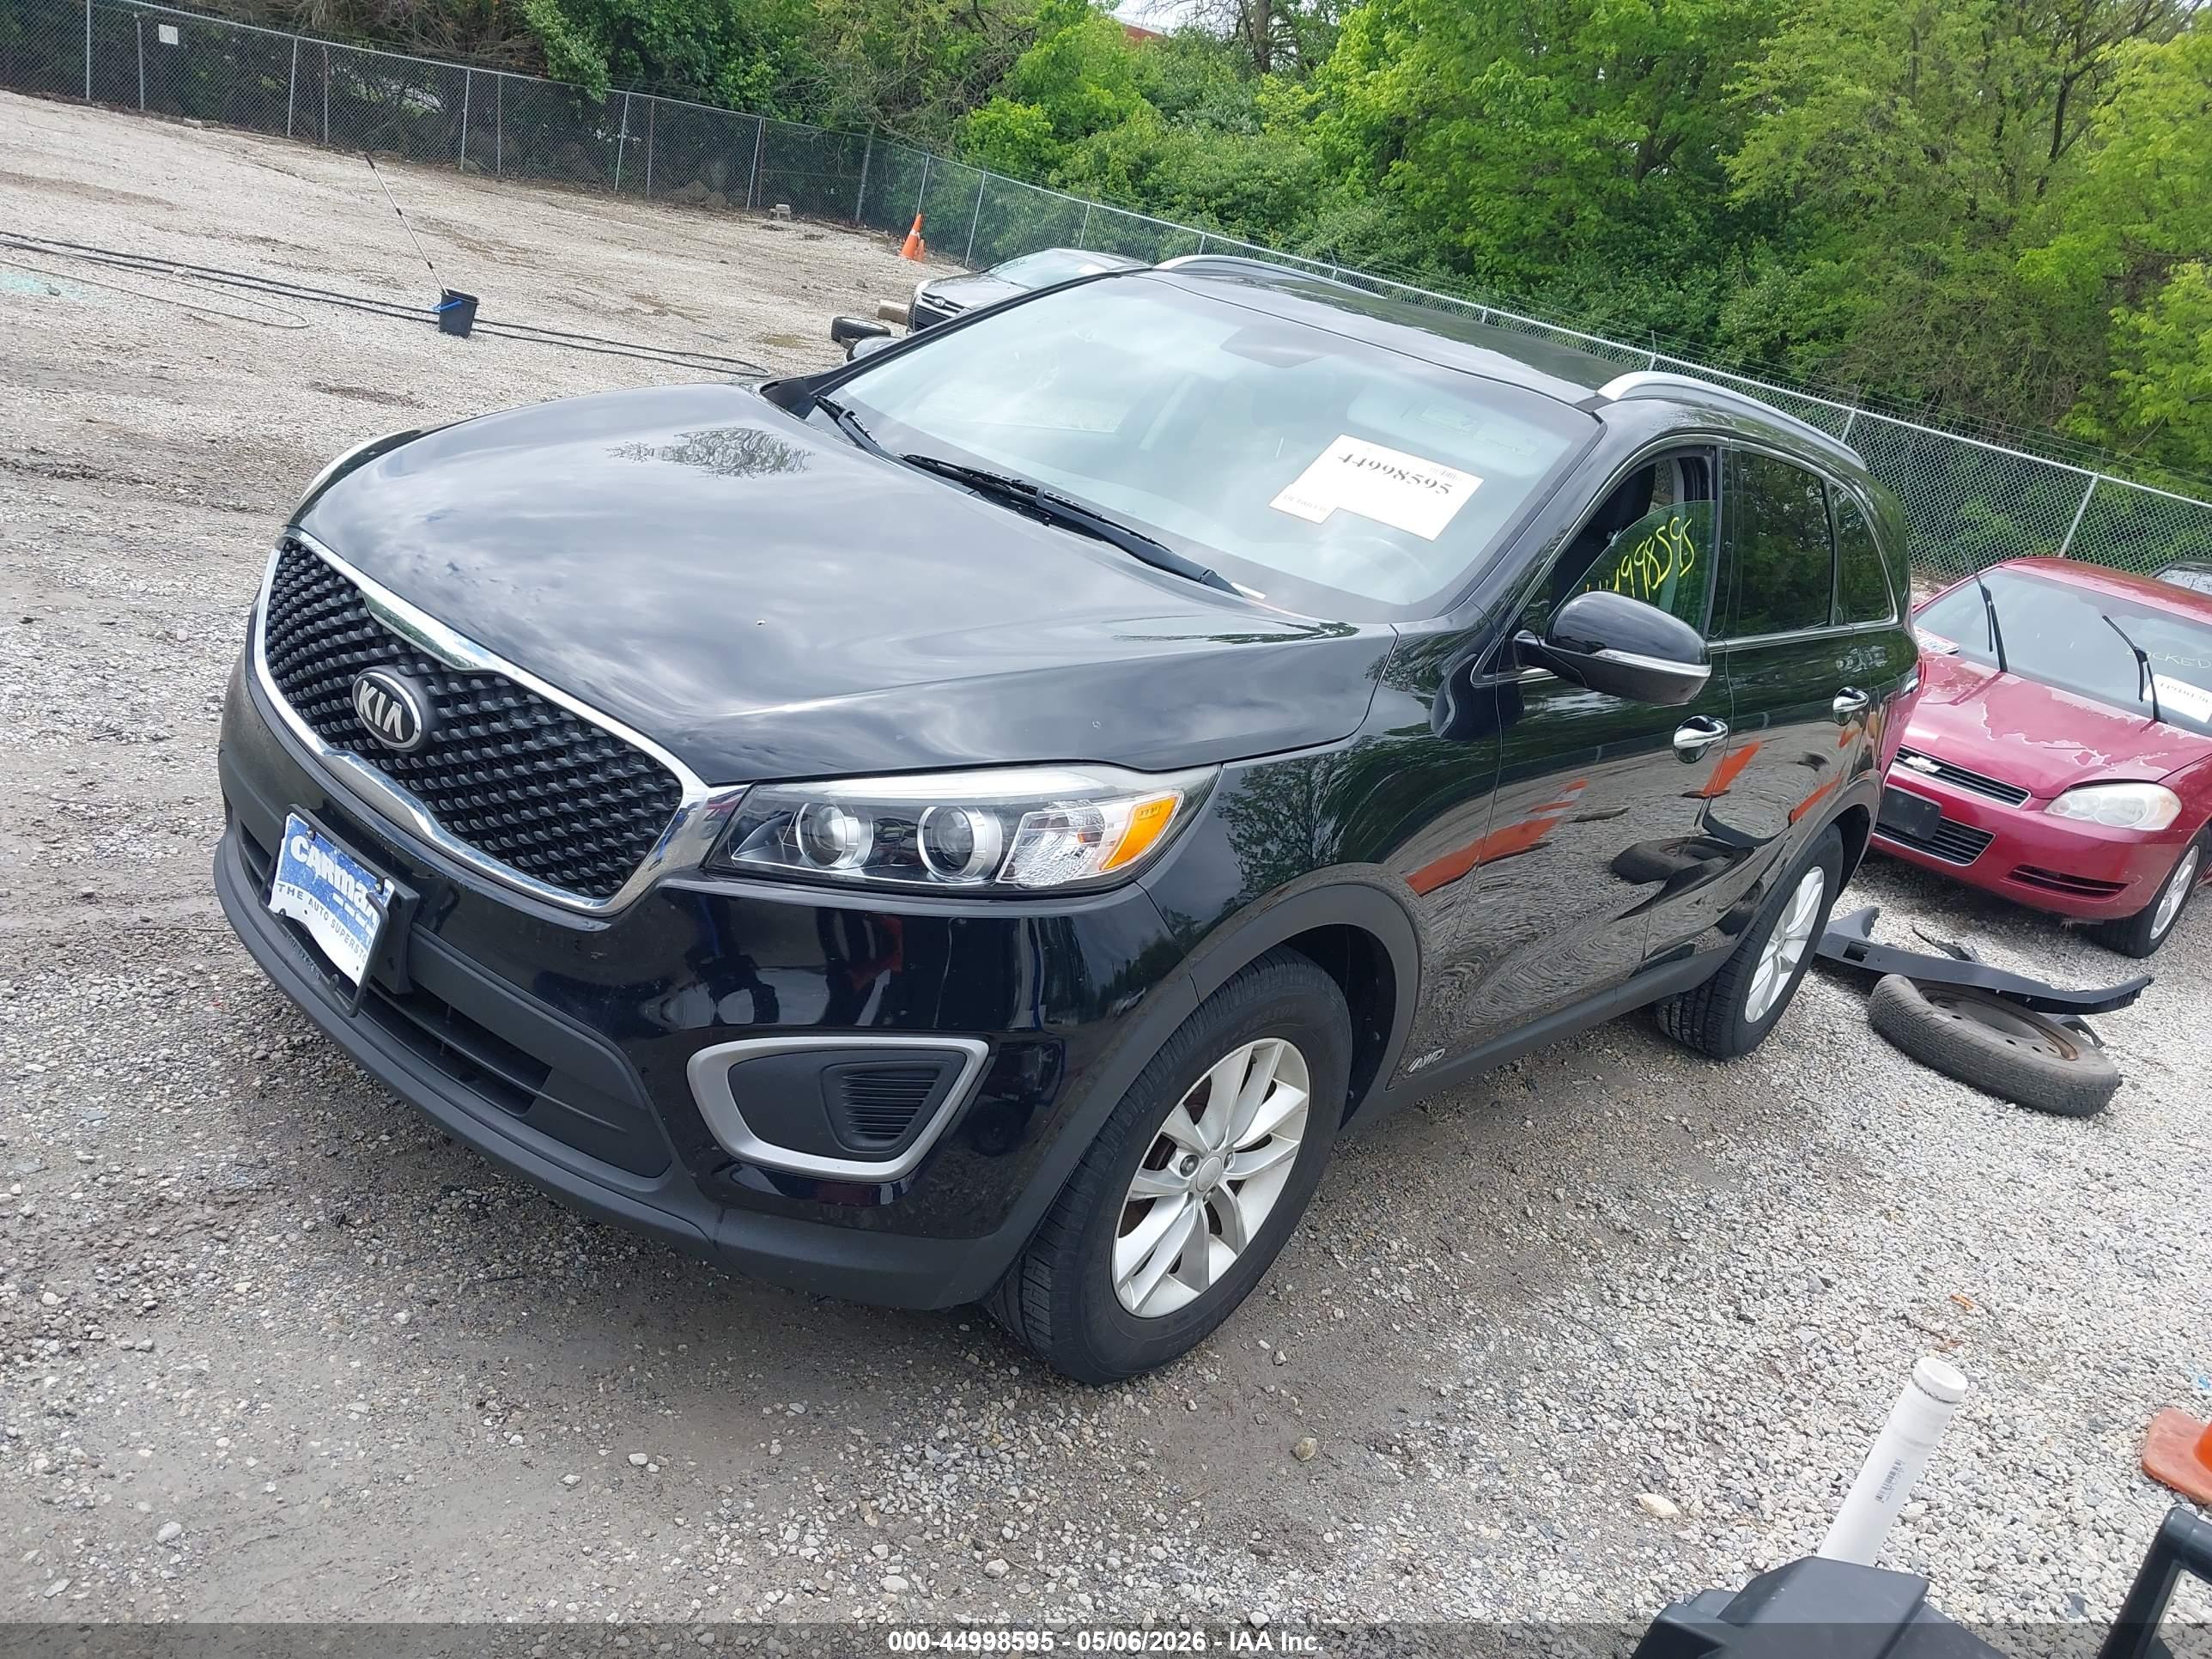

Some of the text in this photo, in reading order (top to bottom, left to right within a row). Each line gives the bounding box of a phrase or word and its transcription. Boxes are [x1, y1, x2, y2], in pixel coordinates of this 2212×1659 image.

[1337, 453, 1453, 495] 44998595
[1587, 517, 1695, 600] 998595
[358, 679, 404, 741] KIA
[277, 884, 304, 900] THE
[307, 897, 330, 921] AUTO
[1407, 1048, 1446, 1073] AWD
